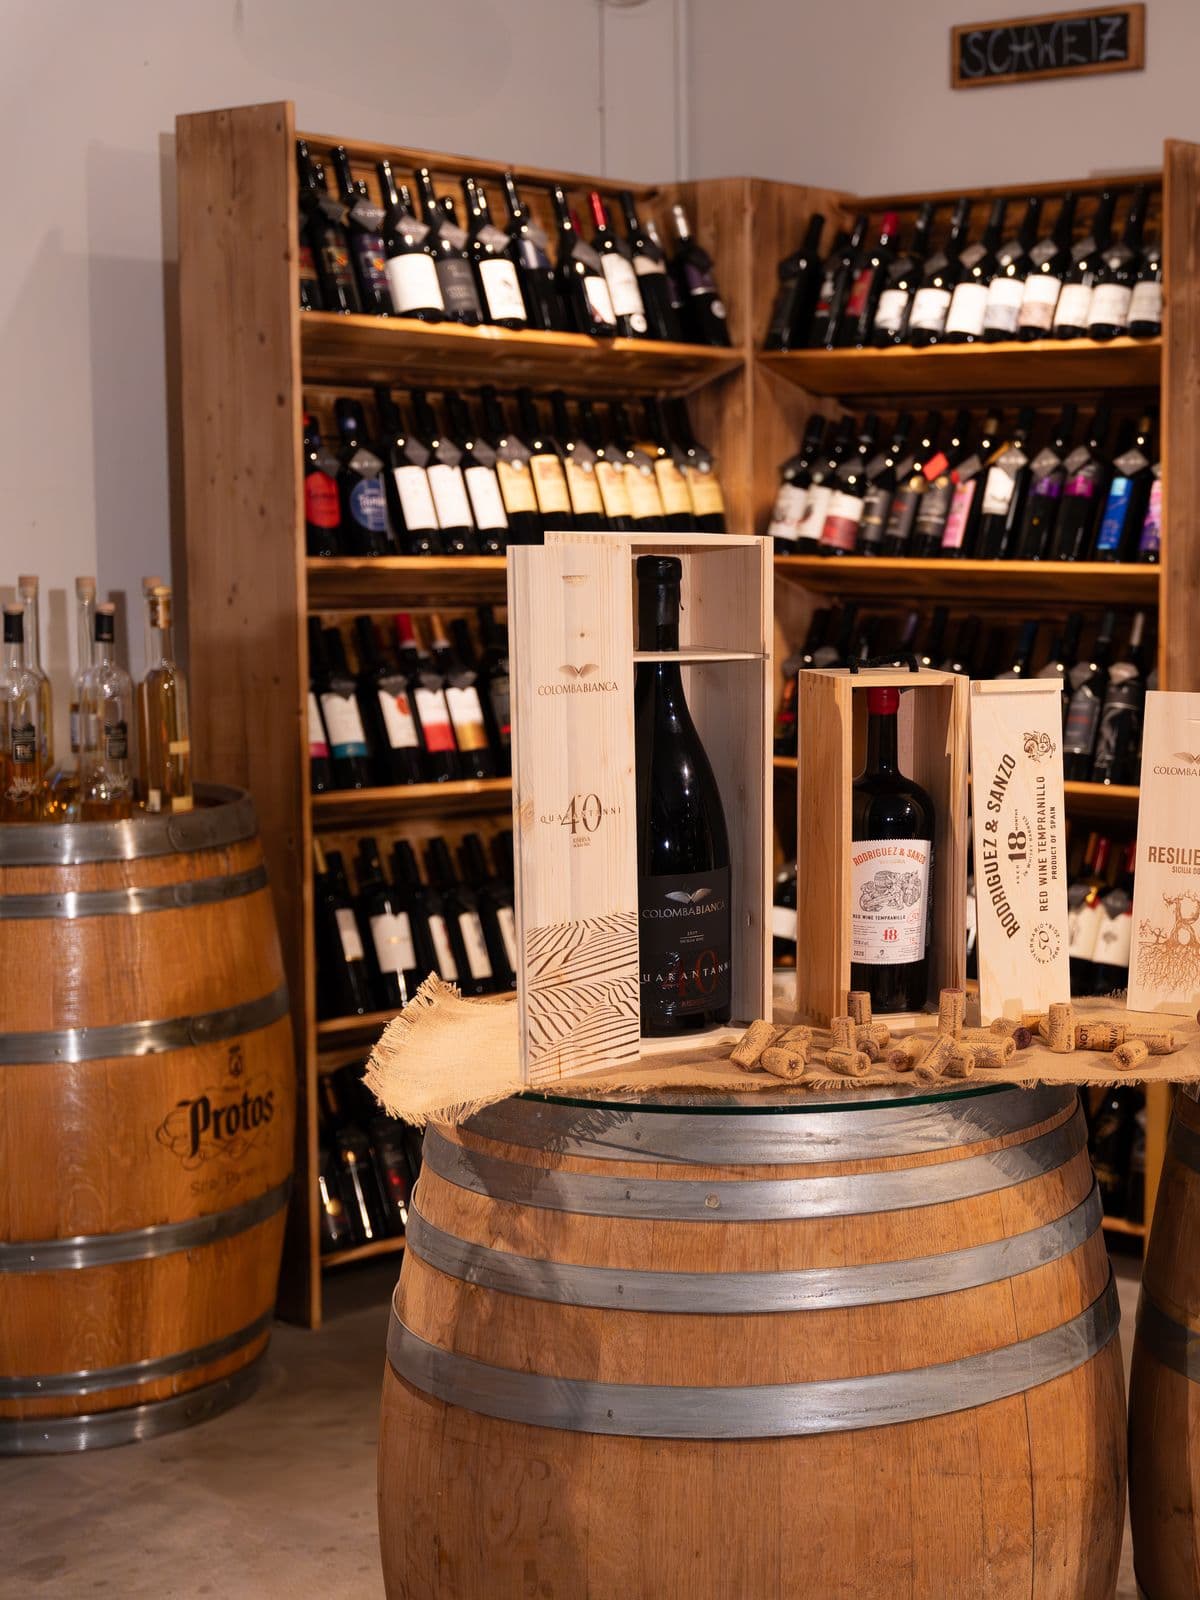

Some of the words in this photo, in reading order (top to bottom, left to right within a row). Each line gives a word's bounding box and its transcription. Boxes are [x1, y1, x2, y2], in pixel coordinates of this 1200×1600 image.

[961, 16, 1126, 77] SCHWEIZ
[537, 681, 619, 696] COLOMBABIANCA
[986, 753, 1016, 813] SANZO
[560, 793, 603, 835] 40
[984, 819, 999, 834] &
[1036, 775, 1047, 853] TEMPRANILLO
[1007, 830, 1027, 862] 18
[1050, 834, 1057, 844] OF
[852, 846, 898, 867] RODRIGUEZ
[898, 846, 906, 856] &
[1037, 857, 1048, 886] WINE
[983, 838, 1021, 939] RODRIGUEZ
[1039, 890, 1049, 912] RED
[883, 928, 898, 941] 18
[177, 1090, 274, 1159] Protos
